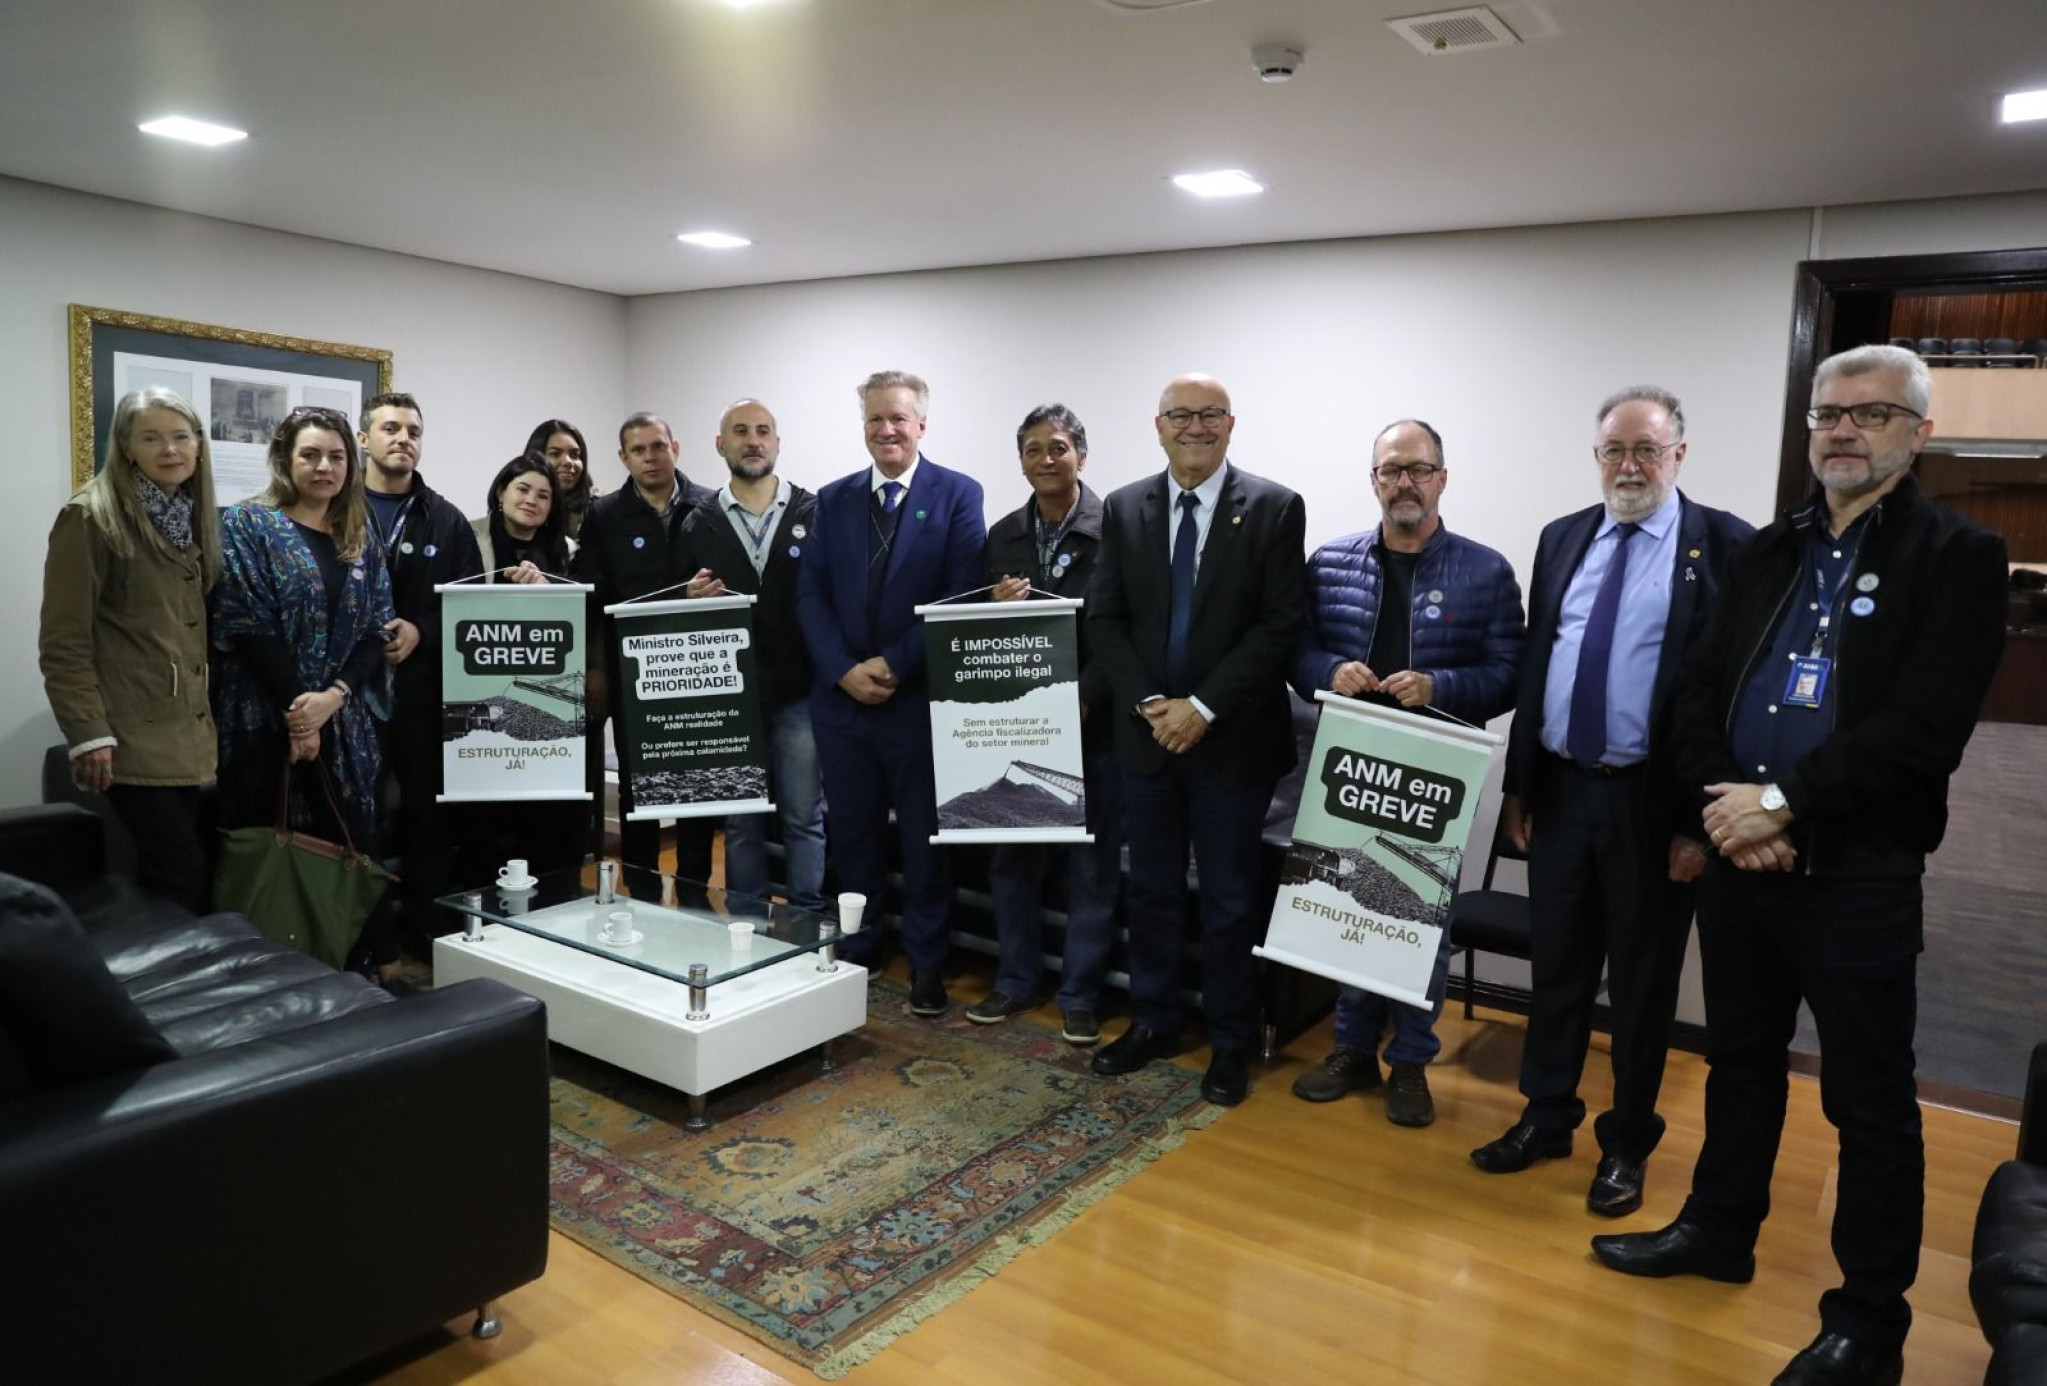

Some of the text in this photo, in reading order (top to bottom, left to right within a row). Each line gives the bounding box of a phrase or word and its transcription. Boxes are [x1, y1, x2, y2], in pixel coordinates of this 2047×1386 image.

[465, 624, 564, 642] ANM em
[628, 632, 743, 650] Ministro Silveira,
[951, 634, 1053, 652] É IMPOSSÍVEL
[474, 647, 556, 665] GREVE
[646, 649, 728, 666] prove que a
[963, 652, 1042, 665] combater o
[645, 661, 731, 679] mineração é
[955, 664, 1052, 682] garimpo ilegal
[642, 676, 738, 693] PRIORIDADE!
[646, 713, 666, 723] Faça
[675, 710, 727, 720] estruturação
[728, 709, 739, 717] da
[963, 716, 1049, 727] Sem estruturar a
[664, 719, 724, 731] ANM realidade
[952, 726, 1061, 739] Agência fiscalizadora
[641, 735, 749, 751] Ou prefere ser responsável
[966, 737, 1049, 748] do setor mineral
[458, 744, 572, 759] ESTRUTURAÇÃO,
[642, 744, 748, 760] pela próxima calamidade?
[505, 757, 526, 770] JÁ!
[1333, 754, 1452, 804] ANM em
[1338, 784, 1437, 829] GREVE
[1291, 896, 1422, 948] ESTRUTURAÇÃO,
[1340, 927, 1365, 945] JÁ!
